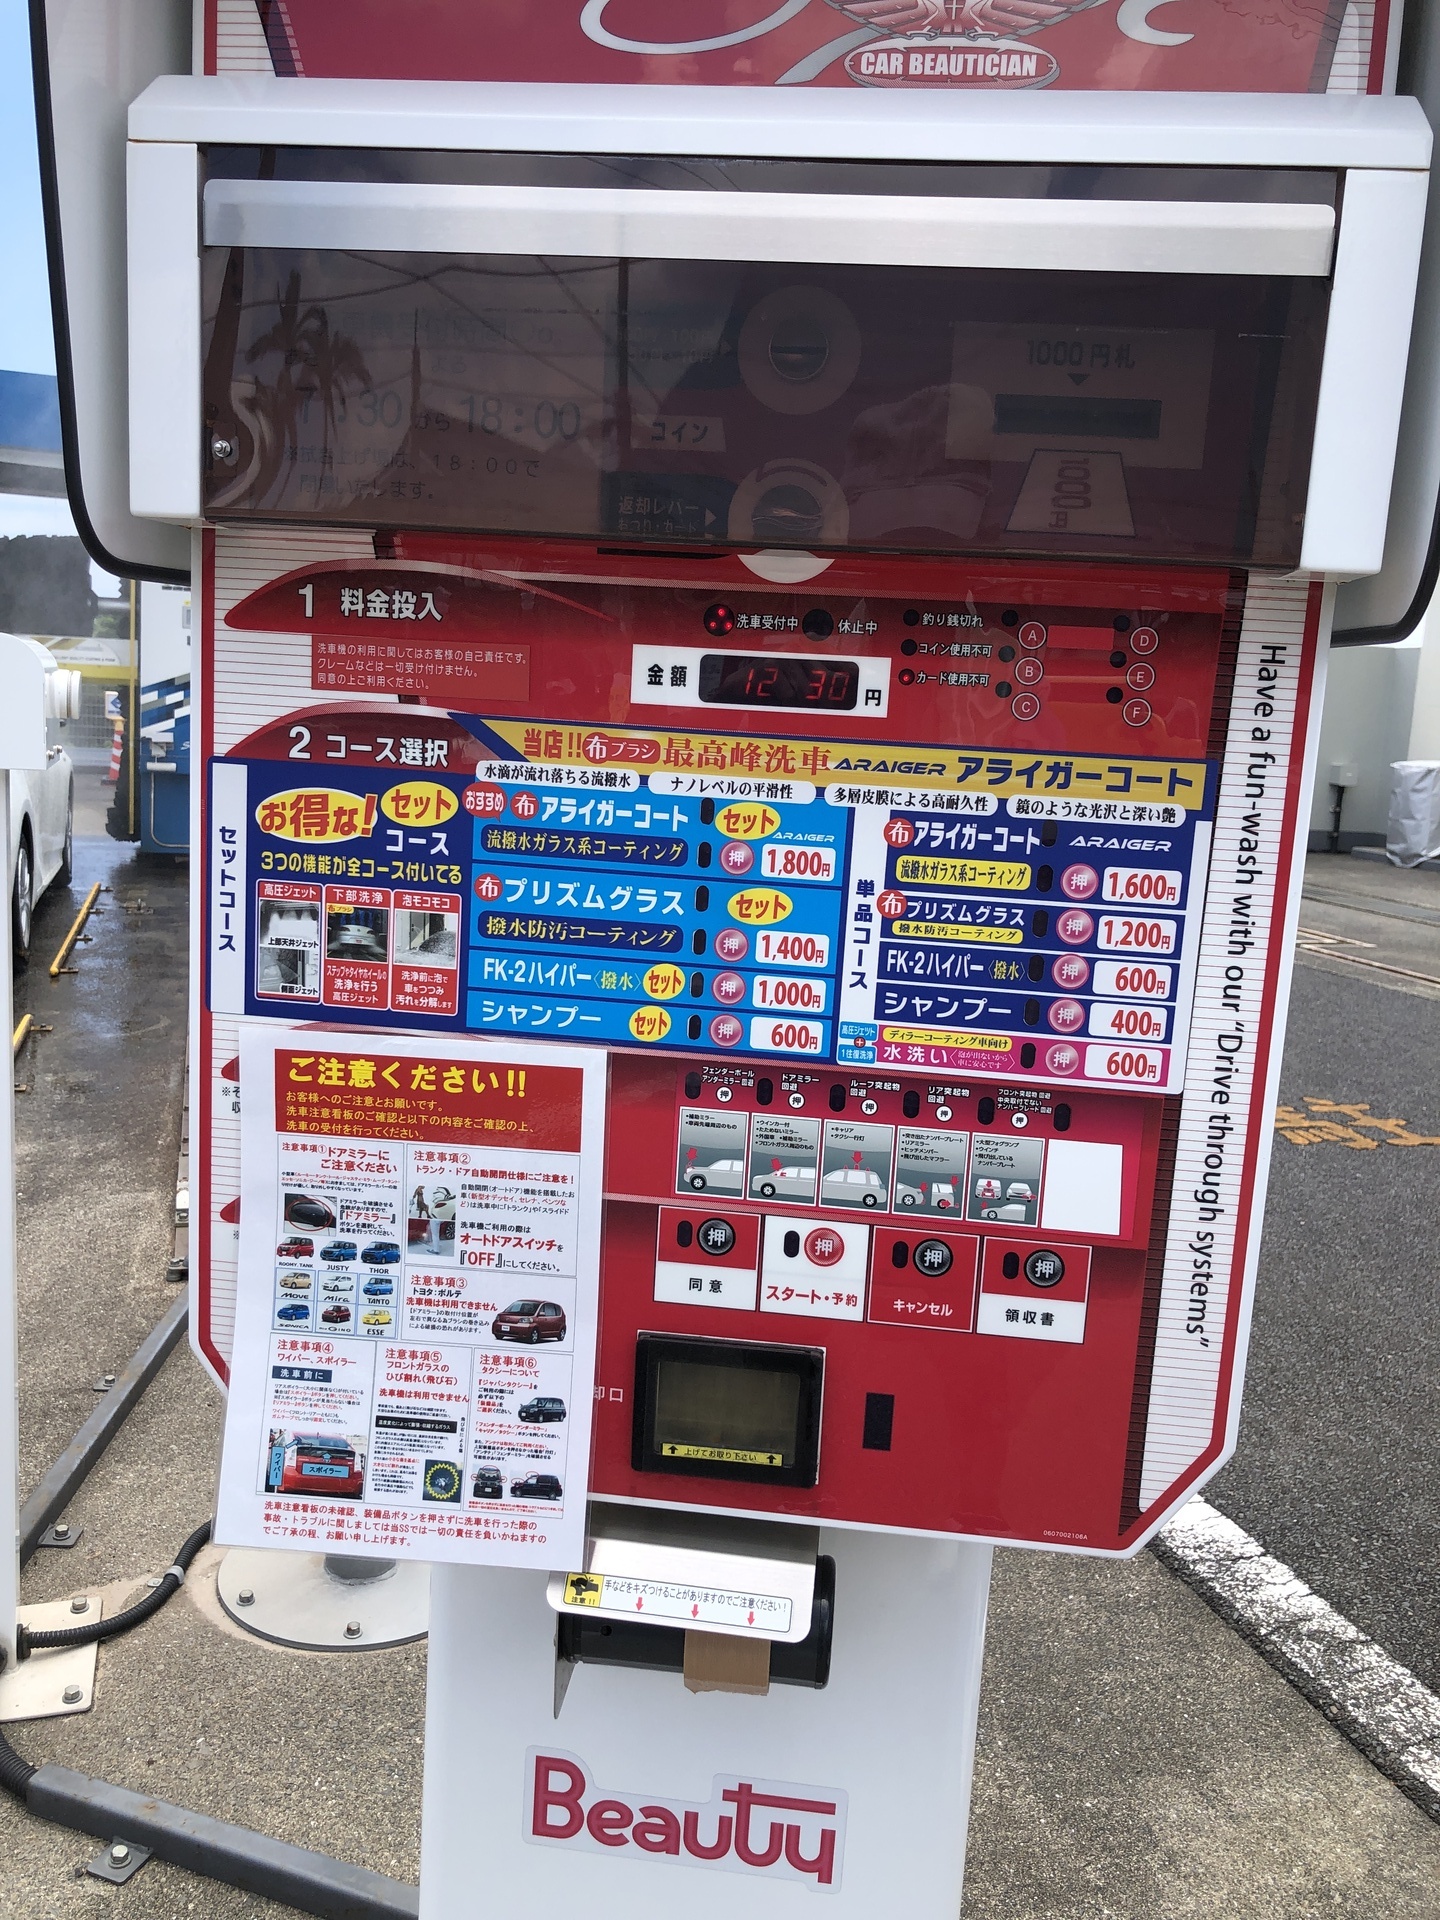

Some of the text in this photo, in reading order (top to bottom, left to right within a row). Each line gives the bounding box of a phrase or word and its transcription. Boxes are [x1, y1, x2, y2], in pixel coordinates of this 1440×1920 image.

[861, 53, 1037, 76] CAR BEAUTICIAN
[1027, 339, 1136, 369] 1000円札
[461, 394, 582, 440] 18:00
[651, 421, 709, 443] コイン
[618, 494, 700, 516] 返却レバー
[298, 584, 443, 623] 1 料金投入
[736, 611, 799, 633] 洗車受付中
[837, 618, 878, 636] 休止中
[921, 611, 984, 629] 釣り銭切れ
[317, 640, 530, 665] 洗車機の利用に関してはお客様の自己責任です。
[918, 641, 992, 659] コイン使用不可
[317, 657, 479, 678] クレームなどは一切受け付けません。
[647, 662, 688, 688] 金額
[317, 672, 430, 691] 同意の上ご利用ください。
[806, 668, 848, 700] 30
[916, 670, 990, 688] カード使用不可
[1253, 643, 1288, 718] Have
[864, 689, 882, 707] 円
[1252, 725, 1273, 741] a
[289, 726, 449, 768] 2 コース選択
[586, 732, 607, 758] 布
[609, 739, 657, 760] ブラシ
[662, 735, 832, 778] 最高峰洗車
[832, 756, 947, 777] ARAIGER
[955, 754, 1195, 793] アライガーコート
[484, 762, 632, 788] 水滴が流れ落ちる流撥水
[671, 776, 794, 800] ナノレベルの平滑性
[392, 790, 452, 820] セット
[833, 786, 989, 813] 多層皮膜による高耐久性
[466, 790, 775, 835] おすすめ 布 アライガーコート セット
[1016, 798, 1177, 824] 鏡のような光沢と深い艶
[1233, 750, 1275, 885] fun-wash
[386, 829, 450, 856] コース
[487, 830, 684, 862] 流撥水ガラス系コーティング
[772, 832, 835, 843] ARAIGER
[887, 821, 1040, 855] 布 アライガーコート
[1068, 835, 1172, 852] ARAIGER
[261, 852, 463, 885] 3つの機能が全コース付いてる
[767, 848, 832, 878] 1,800円
[900, 858, 1027, 887] 流撥水ガラス系コーティング
[219, 826, 237, 952] セットコース
[264, 884, 317, 900] 高圧ジェット
[333, 889, 384, 904] 下部洗浄
[1109, 871, 1177, 902] 1,600円
[402, 895, 451, 909] 泡モコモコ
[479, 876, 787, 920] 布 プリズムグラス セット
[881, 893, 1026, 927] 布 プリズムグラス
[487, 916, 677, 948] 撥水防汚コーティング
[850, 879, 875, 990] 単品コース
[898, 924, 1020, 942] 撥水防汚コーティング
[1104, 919, 1171, 951] 1,200円
[1227, 894, 1257, 958] with
[268, 936, 320, 949] 上部天井ジェット
[761, 934, 825, 964] 1,400円
[484, 958, 682, 994] FK-2ハイパー セット
[887, 950, 984, 980] FK-2ハイパー
[334, 980, 378, 992] 洗浄を行う
[401, 971, 449, 984] 洗浄前に泡で
[1115, 967, 1166, 996] 600円
[281, 984, 318, 995] 側面ジェット
[333, 992, 379, 1004] 高圧ジェット
[404, 984, 445, 996] 車をつつみ
[759, 979, 822, 1009] 1,000円
[1225, 966, 1246, 1014] our
[395, 995, 453, 1009] 汚れを分解します
[884, 992, 1012, 1021] シャンプー
[482, 1001, 668, 1036] シャンプー セット
[1111, 1009, 1162, 1037] 400円
[771, 1025, 818, 1050] 600円
[883, 1044, 948, 1064] 水洗い
[1106, 1051, 1157, 1079] 600円
[289, 1055, 527, 1098] ご注意ください!!
[782, 1074, 820, 1084] ドアミラー
[850, 1080, 901, 1092] ルーフ突起物
[286, 1091, 444, 1112] お客様へのご注意とお願いです。
[928, 1086, 970, 1098] リア突起物
[286, 1105, 536, 1133] 洗車注意看板のご確認と以下の内容をご確認の上、
[286, 1119, 426, 1140] 洗車の受付を行ってください。
[328, 1146, 390, 1161] ドアミラーに
[413, 1150, 472, 1165] 注意事項②
[1192, 1110, 1230, 1219] through
[321, 1159, 398, 1174] ご注意ください
[460, 1221, 532, 1234] 洗車機ご利用の際は
[460, 1232, 564, 1253] オートドアスイッチを
[327, 1264, 350, 1272] JUSTY
[369, 1267, 390, 1275] THOR
[411, 1274, 468, 1289] 注意事項③
[688, 1277, 724, 1295] 同意
[367, 1297, 390, 1306] TANTO
[406, 1296, 498, 1312] 洗車機は利用できません
[766, 1285, 858, 1308] スタート・予約
[893, 1298, 954, 1318] キャンセル
[1005, 1308, 1056, 1327] 領収書
[367, 1328, 385, 1336] ESSE
[277, 1338, 334, 1354] 注意事項④
[385, 1348, 442, 1362] 注意事項⑤
[277, 1352, 357, 1366] ワイパー、スポイラー
[386, 1360, 450, 1373] フロントガラスの
[480, 1353, 537, 1369] 注意事項⑥
[280, 1368, 324, 1380] 洗車前に
[481, 1366, 540, 1378] タクシーについて
[379, 1388, 470, 1403] 洗車機は利用できません
[273, 1452, 281, 1479] ワイパー
[309, 1466, 342, 1474] スポイラー
[264, 1501, 537, 1530] 洗車注意看板の未確認、装備品ボタンを押さずに洗車を行った際の
[262, 1526, 412, 1548] でご了承の程、お願い申し上げます。
[263, 1514, 548, 1543] 事故・トラブルに関しましては当SSでは一切の責任を負いかねますの
[531, 1754, 837, 1885] Beauty
